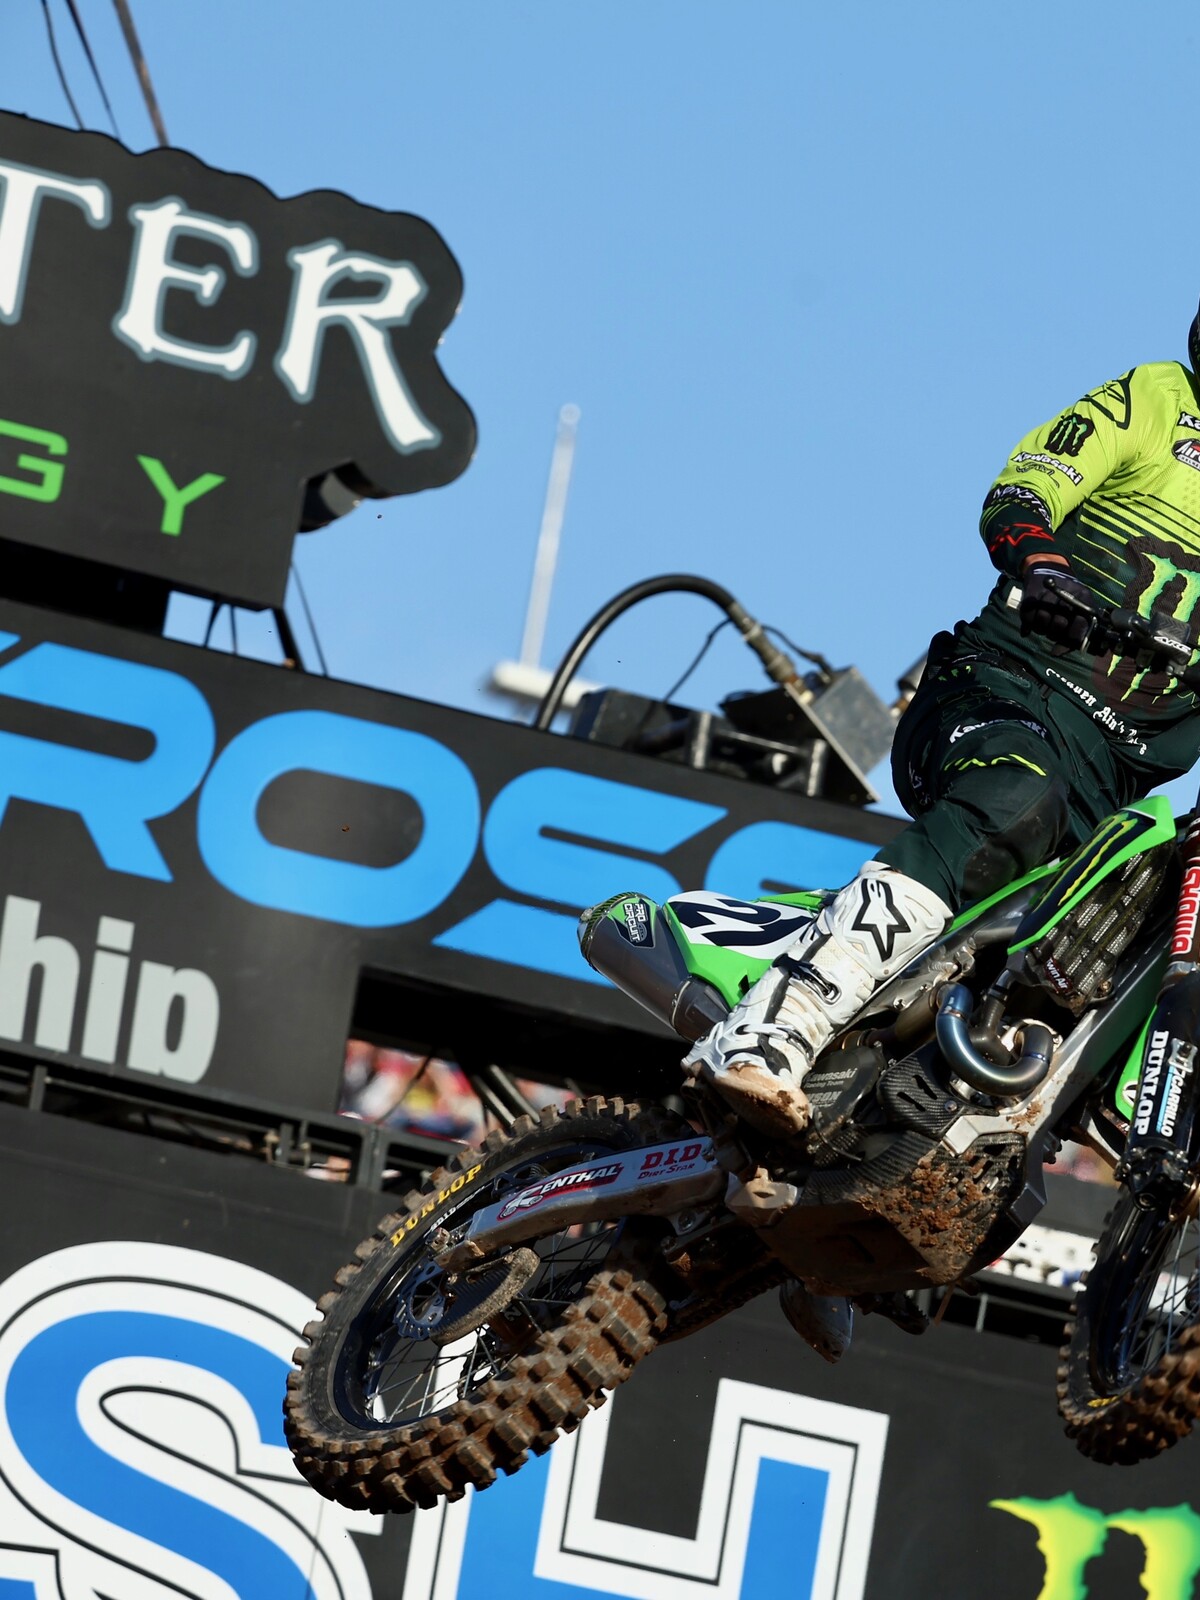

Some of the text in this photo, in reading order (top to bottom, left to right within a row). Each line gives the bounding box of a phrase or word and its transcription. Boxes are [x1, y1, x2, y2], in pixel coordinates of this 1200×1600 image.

[1012, 452, 1082, 485] Kawasaki
[0, 641, 893, 988] ROS
[624, 903, 641, 943] CIRCUIT
[635, 903, 647, 923] PRO
[1134, 1030, 1170, 1136] DUNLOP
[1161, 1073, 1185, 1138] CARRILLO
[389, 1163, 482, 1248] DUNLOP
